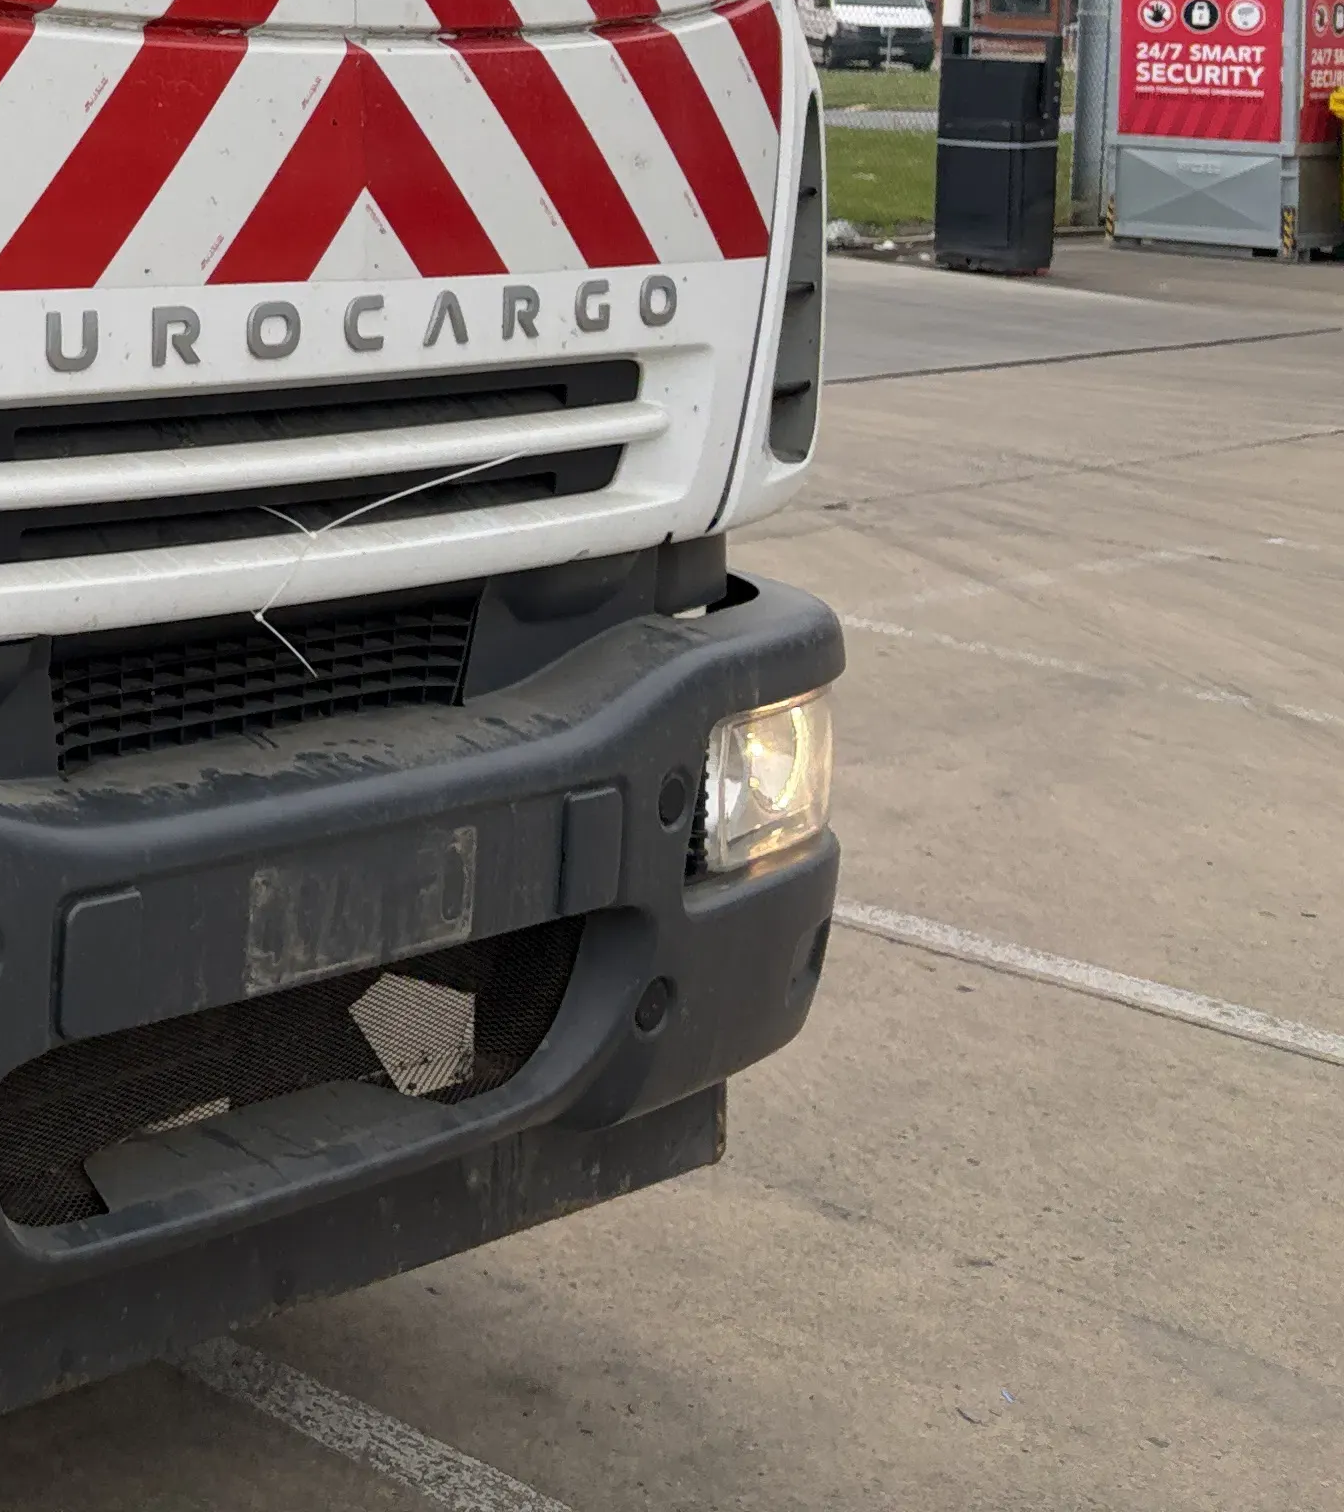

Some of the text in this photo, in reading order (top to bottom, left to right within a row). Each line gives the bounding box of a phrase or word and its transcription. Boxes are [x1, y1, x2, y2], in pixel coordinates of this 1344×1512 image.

[1135, 42, 1265, 63] 24/7 SMART
[1135, 61, 1265, 87] SECURITY
